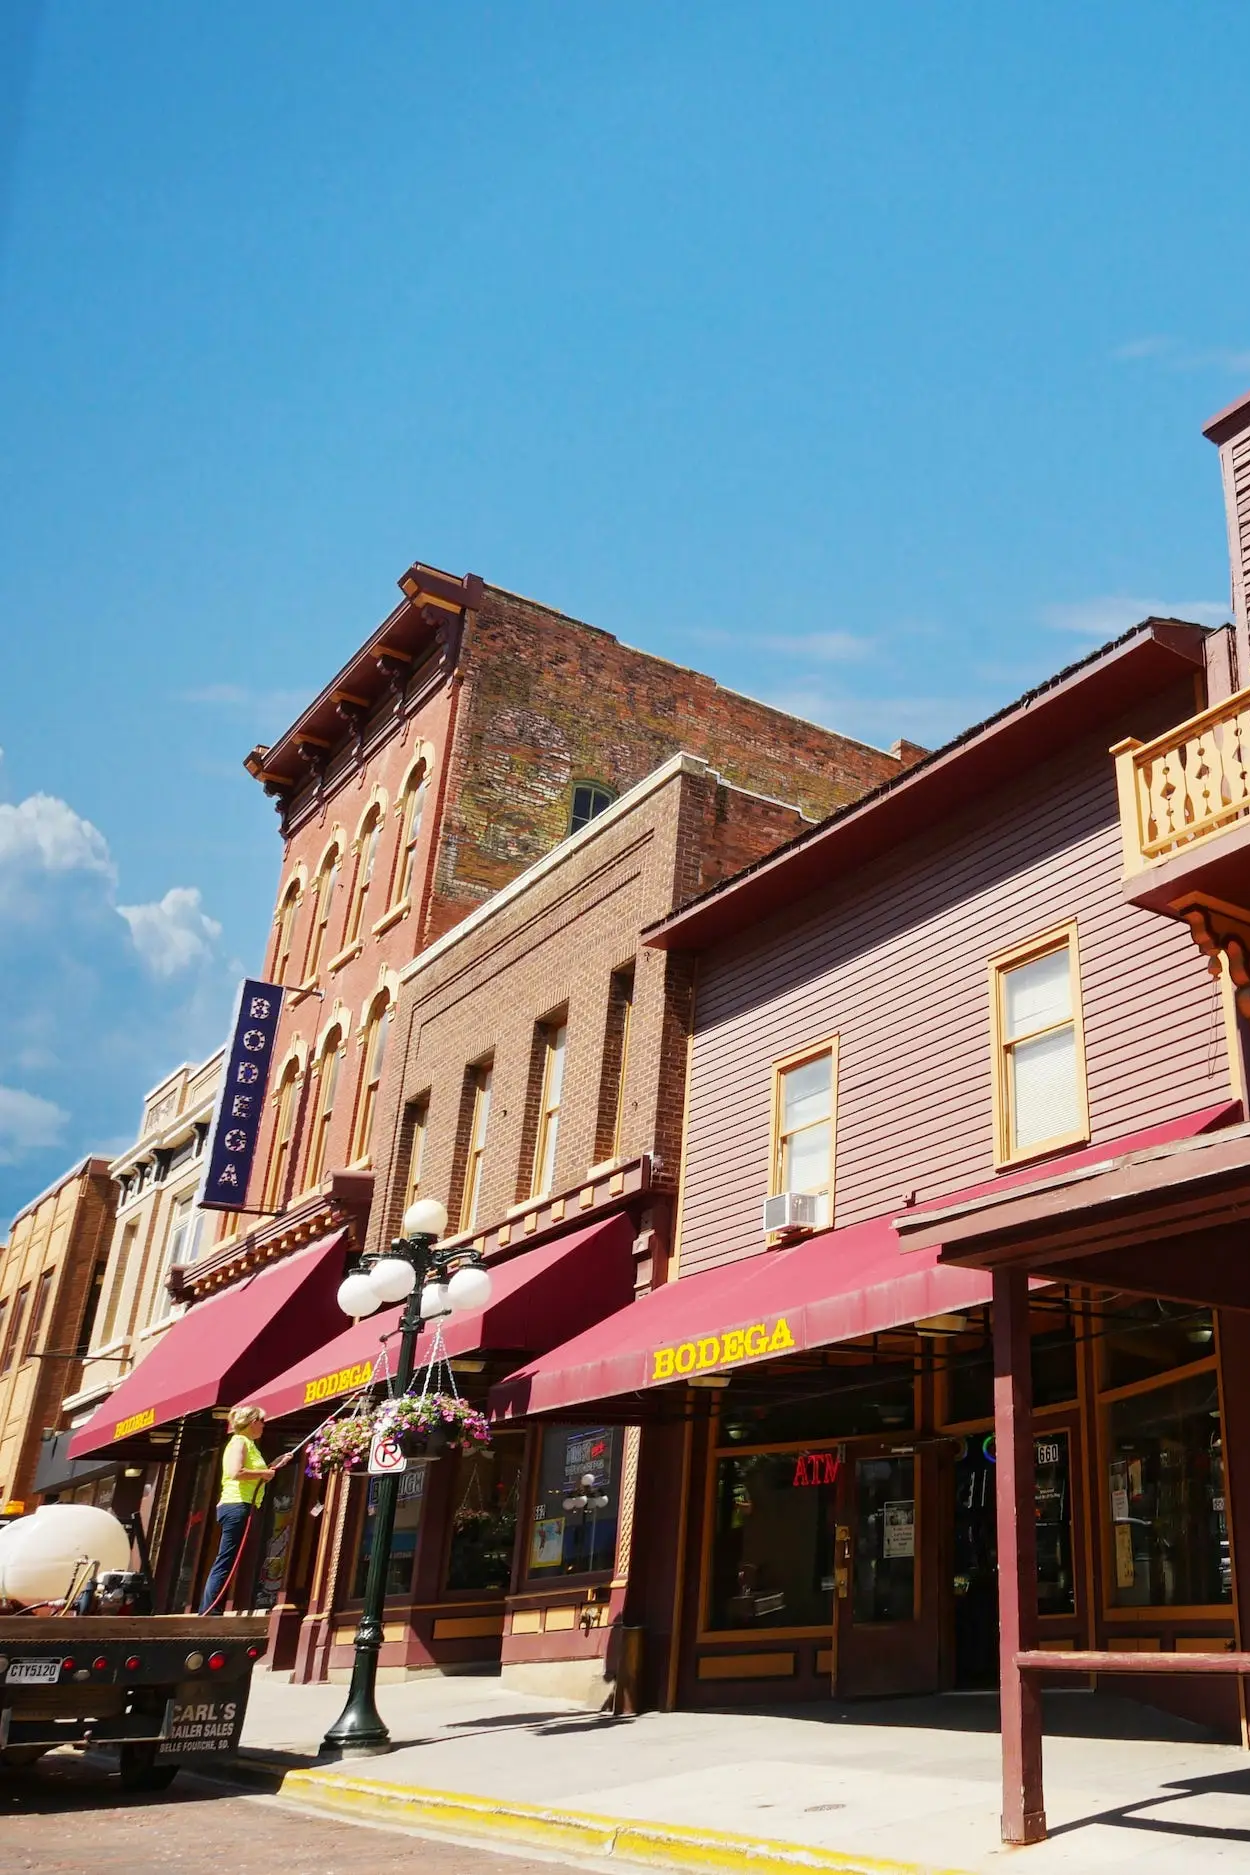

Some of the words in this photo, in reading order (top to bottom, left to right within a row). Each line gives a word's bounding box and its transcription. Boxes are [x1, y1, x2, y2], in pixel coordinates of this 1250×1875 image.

[218, 996, 272, 1188] BODEGA
[652, 1317, 795, 1380] BODEGA
[304, 1361, 373, 1404] BODEGA
[113, 1408, 155, 1439] BODEGA
[793, 1453, 840, 1486] ATM
[1038, 1445, 1058, 1462] 660
[11, 1664, 56, 1677] CTY5120
[203, 1723, 234, 1737] SALES
